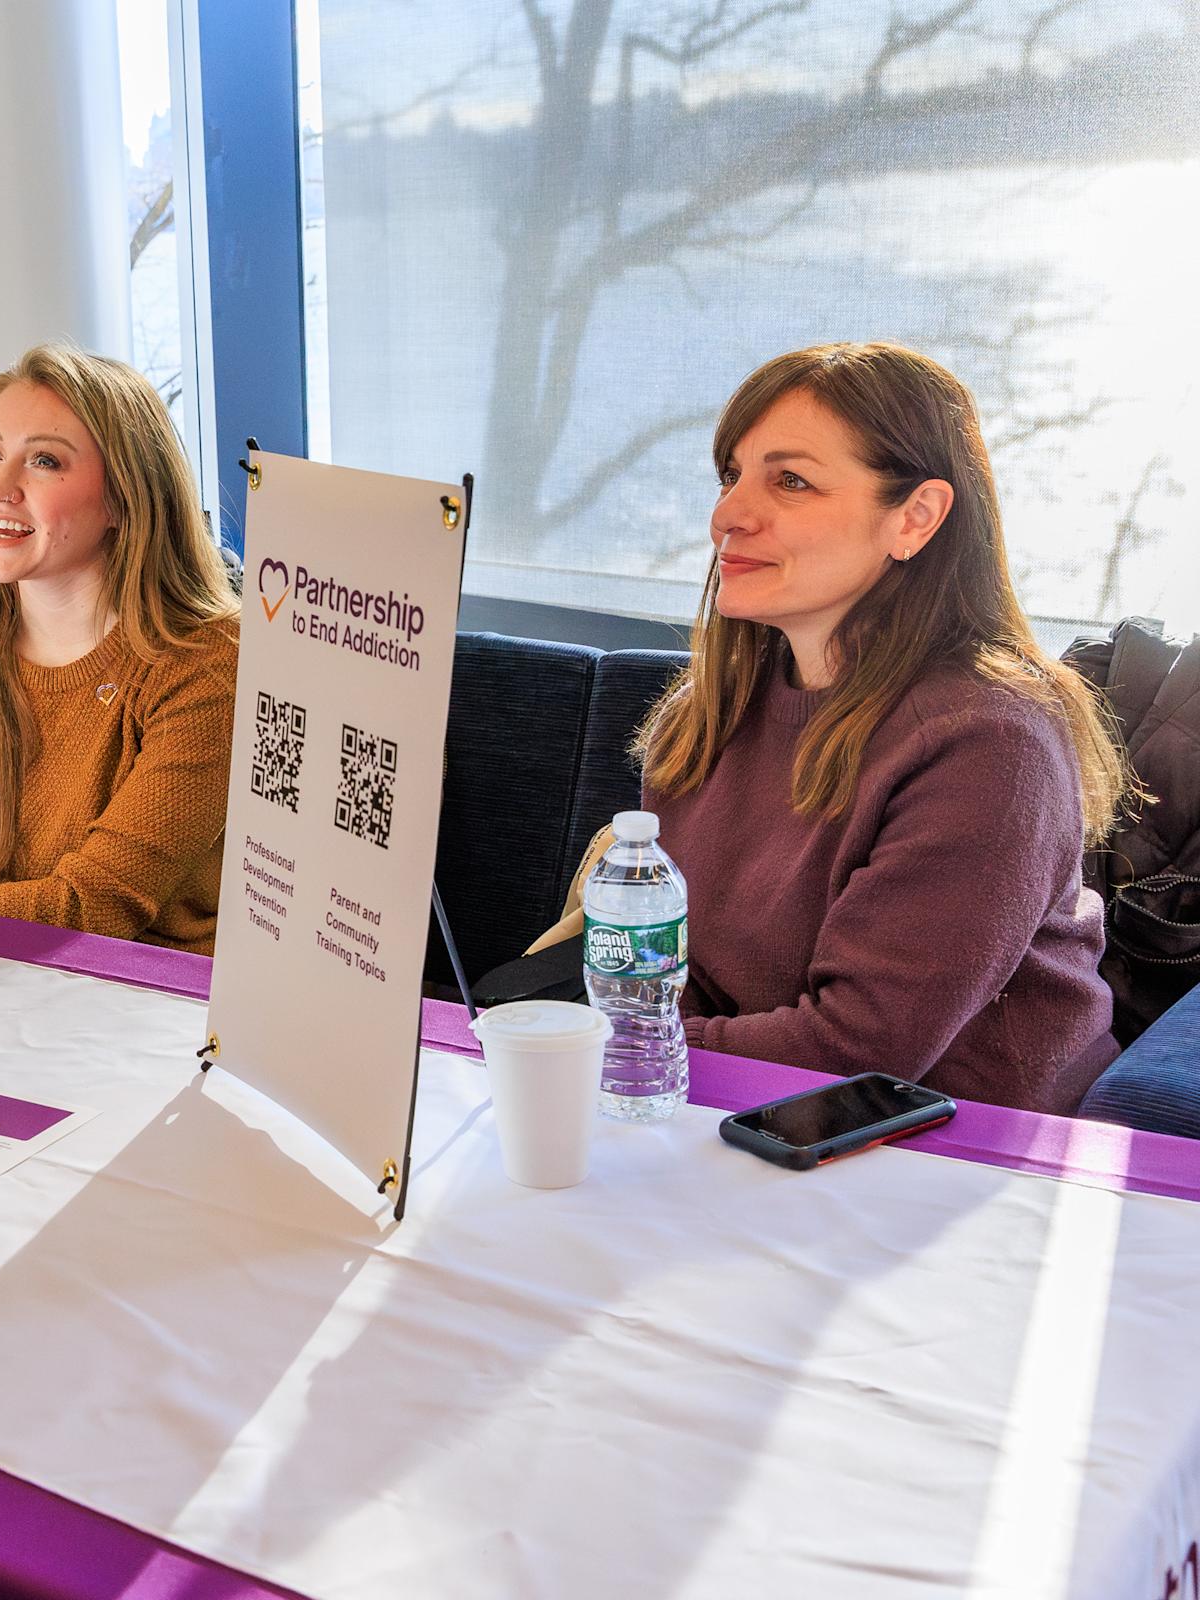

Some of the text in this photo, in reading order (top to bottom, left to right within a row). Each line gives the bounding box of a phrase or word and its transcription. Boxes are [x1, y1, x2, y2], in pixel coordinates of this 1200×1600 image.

[294, 566, 424, 642] Partnership
[292, 610, 420, 671] to End Addiction
[245, 835, 295, 873] Professional
[243, 857, 294, 898] Development
[245, 882, 287, 918] Prevention
[330, 887, 381, 926] Parent and
[249, 907, 280, 941] Training
[326, 911, 379, 955] Community
[587, 929, 632, 947] Poland
[316, 931, 386, 982] Training Topics
[588, 945, 634, 963] Spring
